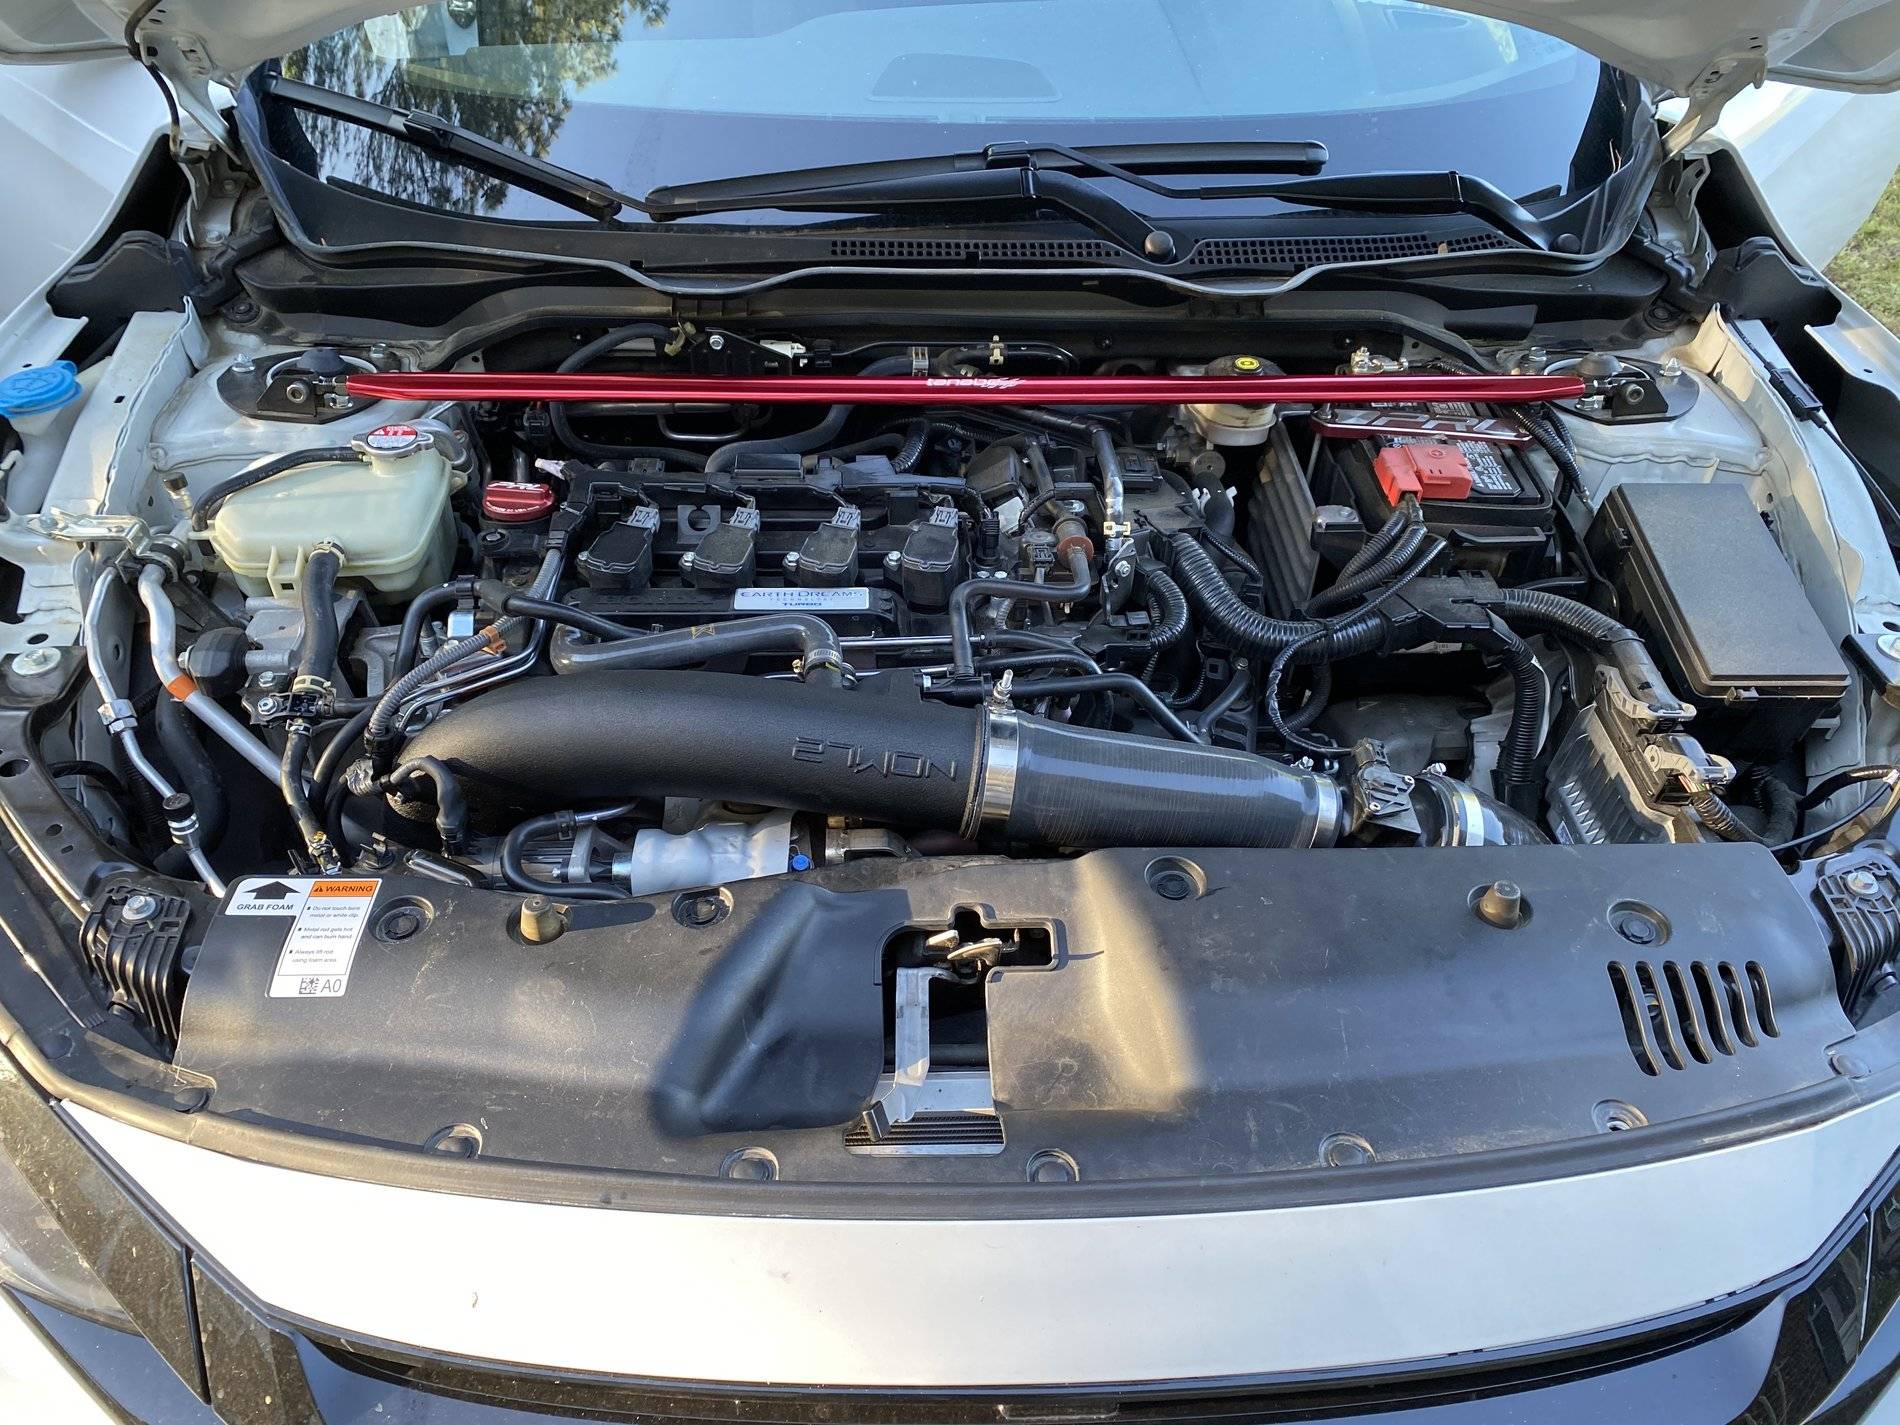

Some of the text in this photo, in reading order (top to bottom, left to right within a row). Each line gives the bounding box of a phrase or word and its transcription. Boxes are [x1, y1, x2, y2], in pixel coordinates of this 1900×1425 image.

[740, 590, 794, 598] EARTH
[791, 736, 958, 783] 27WON
[325, 885, 374, 893] WARNING
[236, 903, 294, 911] GRAB FOAM
[320, 978, 342, 993] A0
